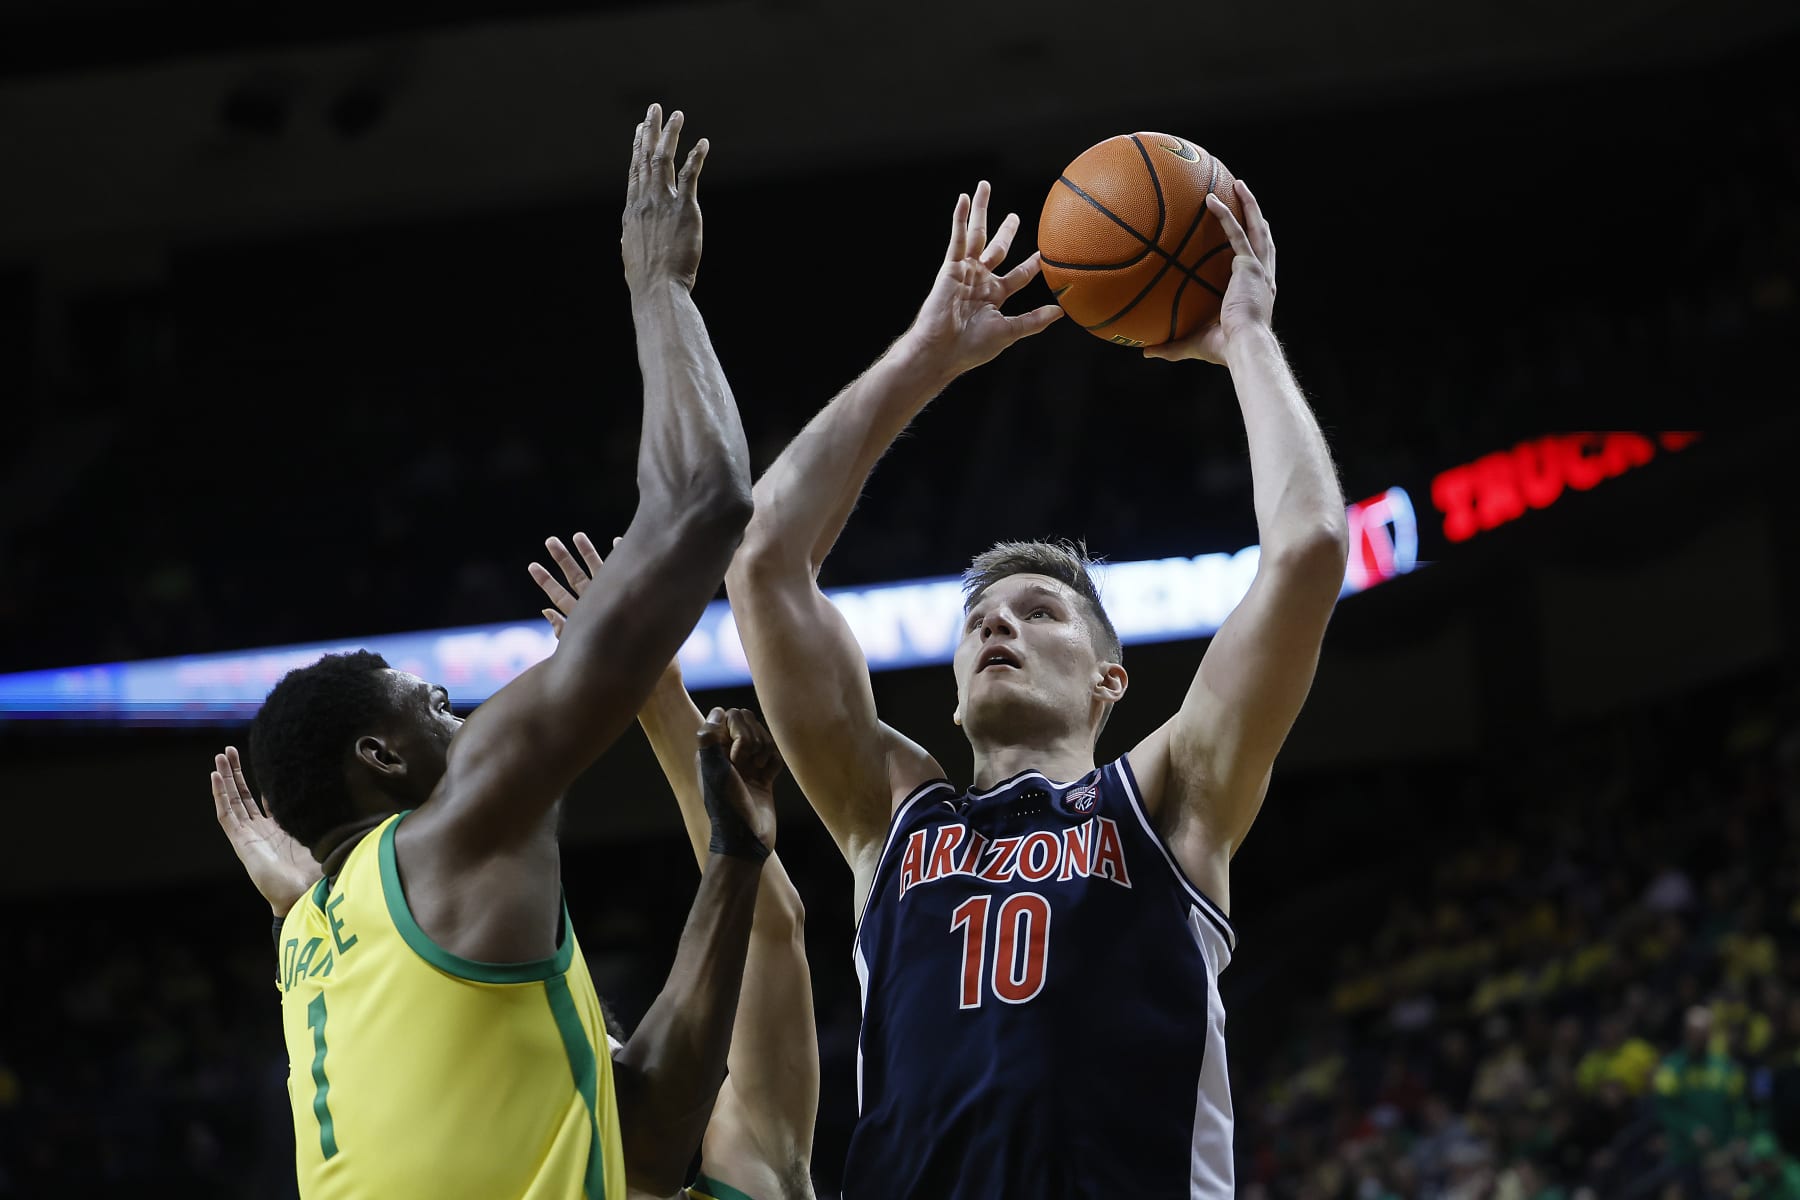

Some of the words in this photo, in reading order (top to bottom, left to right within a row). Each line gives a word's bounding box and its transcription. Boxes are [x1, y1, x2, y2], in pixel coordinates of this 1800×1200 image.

[899, 815, 1132, 901] ARIZONA
[949, 891, 1052, 1010] 10
[307, 991, 340, 1162] 1
